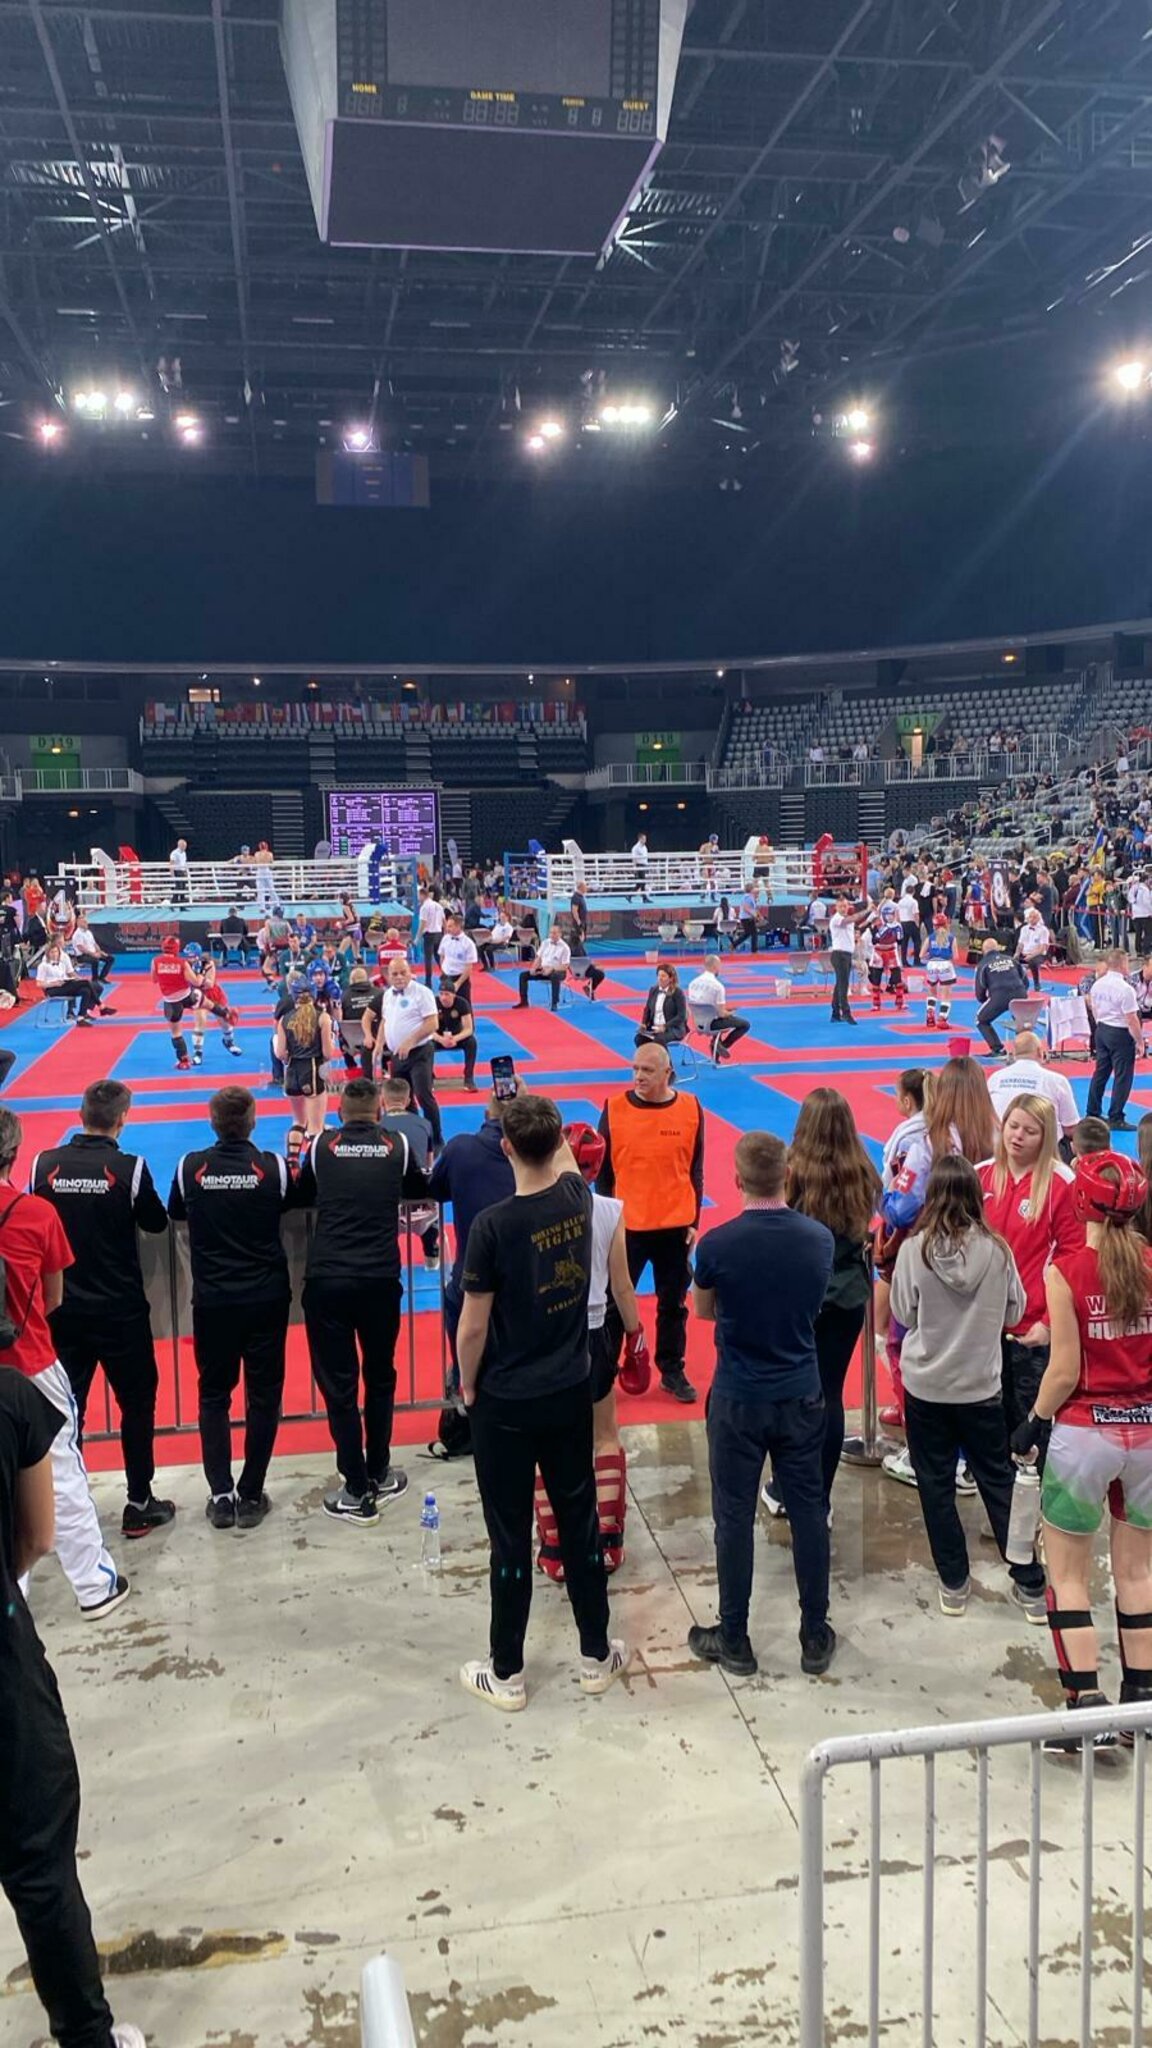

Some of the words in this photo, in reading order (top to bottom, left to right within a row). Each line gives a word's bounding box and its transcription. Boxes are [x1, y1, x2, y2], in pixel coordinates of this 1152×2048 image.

[352, 83, 378, 94] HOME
[470, 90, 494, 102] GAME
[495, 91, 515, 103] TIME
[622, 101, 649, 111] GUEST
[333, 1143, 390, 1155] MINOTAUR
[52, 1178, 110, 1191] MINOTAUR
[201, 1174, 260, 1187] MINOTAUR
[537, 1225, 582, 1252] TIGAR
